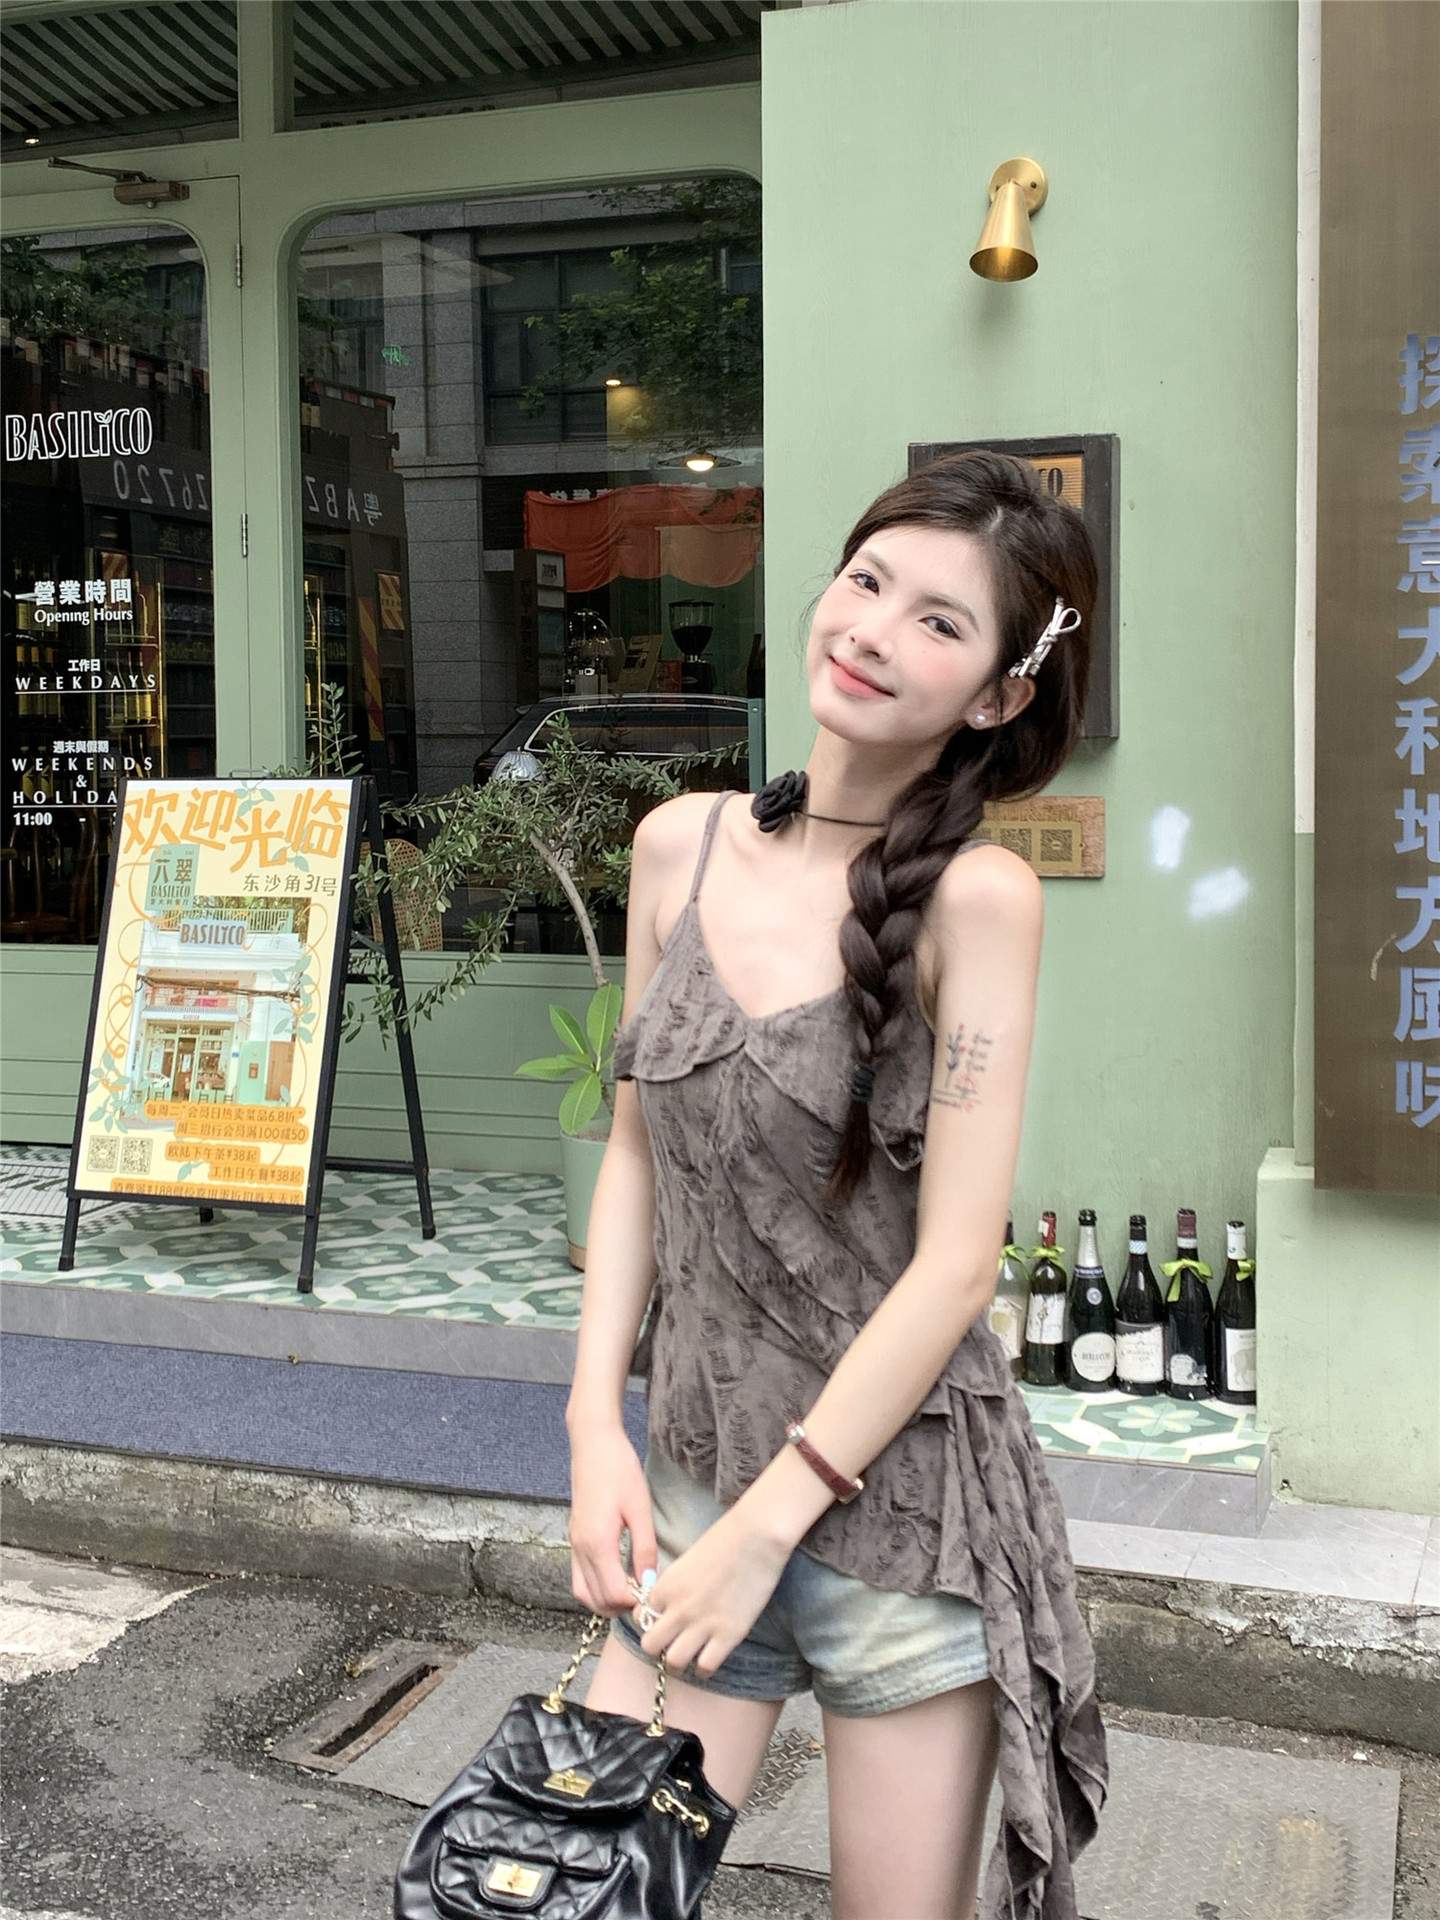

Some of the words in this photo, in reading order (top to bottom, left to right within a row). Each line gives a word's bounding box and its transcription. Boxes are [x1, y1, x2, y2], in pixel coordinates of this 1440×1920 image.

[34, 579, 132, 606] 營業時間
[34, 609, 90, 626] Opening
[94, 608, 133, 621] Hours
[68, 659, 100, 672] 工作日
[15, 675, 156, 690] WEEKDAYS
[12, 757, 153, 771] WEEKENDS
[76, 774, 87, 788] &
[13, 812, 53, 826] 11:00
[123, 787, 349, 873] 欢迎光临
